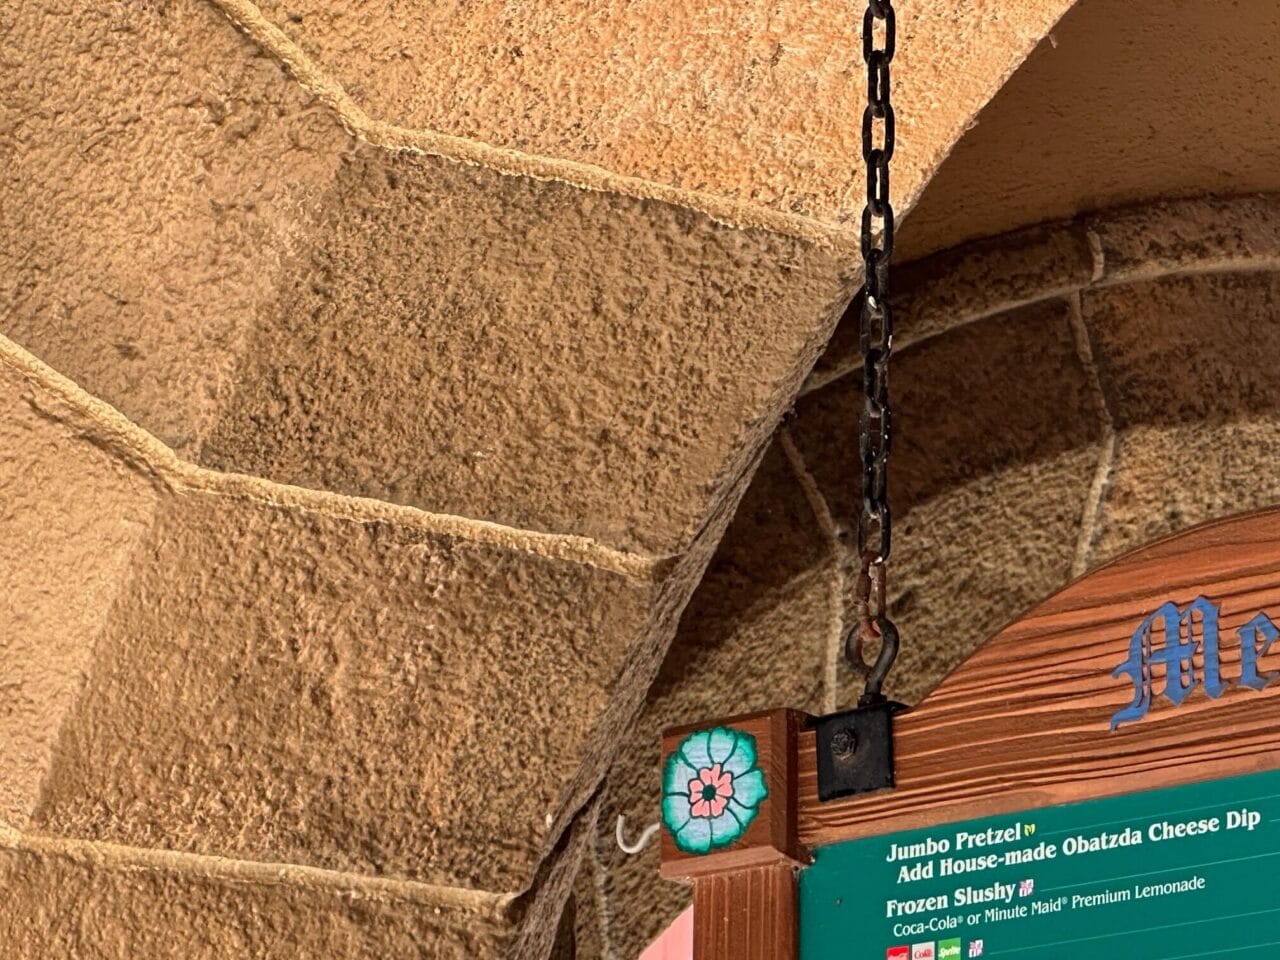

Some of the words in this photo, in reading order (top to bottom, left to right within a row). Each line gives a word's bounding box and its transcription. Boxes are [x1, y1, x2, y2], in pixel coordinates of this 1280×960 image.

[886, 837, 950, 862] Jumbo
[955, 822, 1021, 851] Pretzel
[897, 860, 934, 884] Add
[939, 842, 1057, 877] House-made
[1062, 827, 1143, 856] Obatzda
[1148, 817, 1220, 842] Cheese
[1226, 808, 1261, 831] Dip
[886, 895, 949, 918] Frozen
[954, 881, 1016, 907] Slushy
[966, 913, 981, 925] or
[984, 905, 1028, 922] Minute
[1072, 890, 1131, 909] Premium
[1135, 876, 1205, 899] Lemonade
